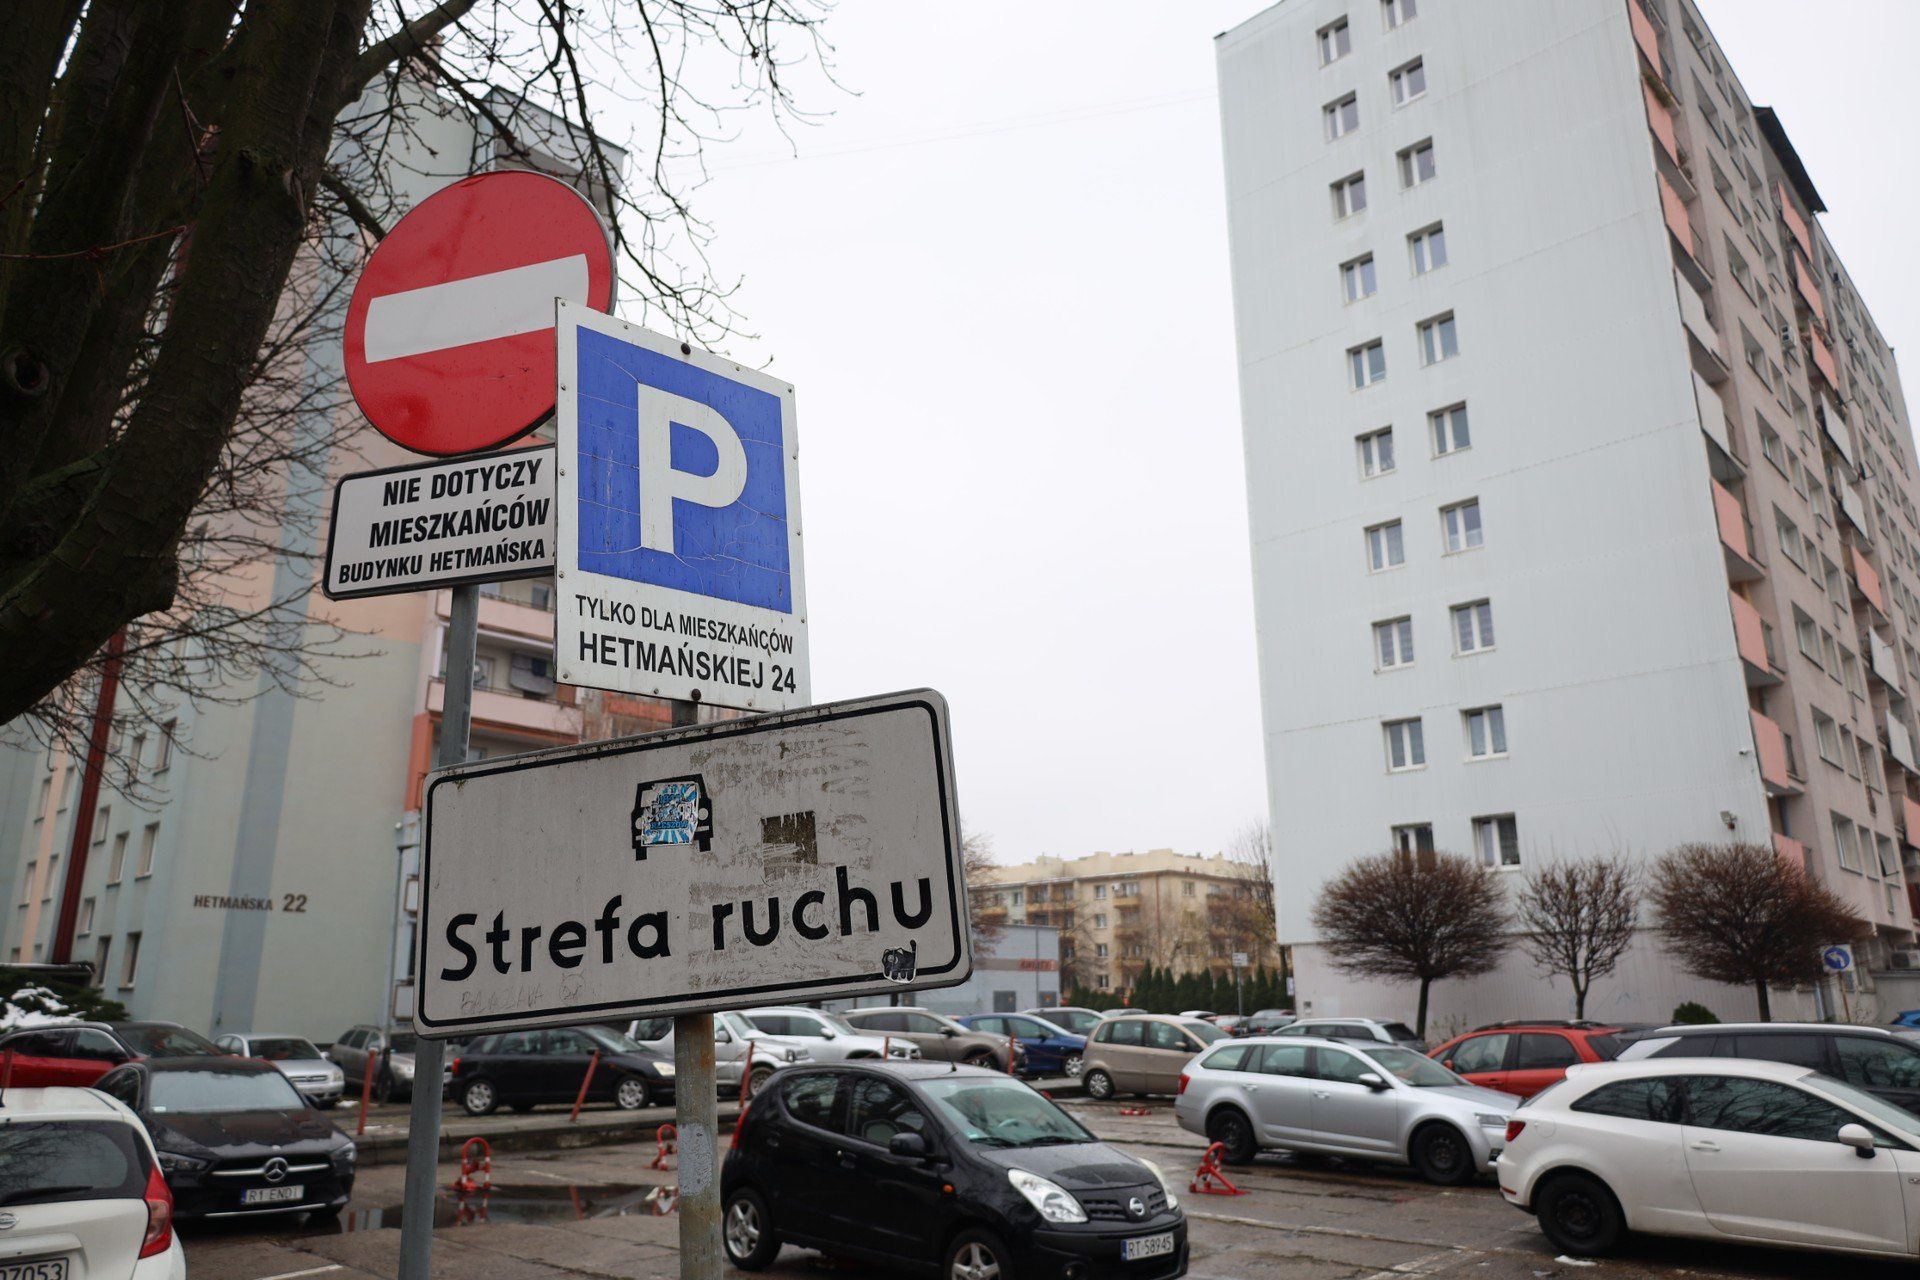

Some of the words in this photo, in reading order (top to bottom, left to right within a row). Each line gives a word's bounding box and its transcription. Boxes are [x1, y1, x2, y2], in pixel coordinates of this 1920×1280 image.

[383, 477, 421, 507] NIE
[430, 458, 543, 500] DOTYCZY
[638, 382, 748, 554] P
[368, 494, 551, 548] MIESZKAŃCÓW
[338, 554, 423, 584] BUDYNKU
[429, 537, 545, 572] HETMAŃSKA
[575, 594, 636, 626] TYLKO
[641, 606, 675, 633] DLA
[679, 614, 793, 654] MIESZKAŃCÓW
[579, 630, 764, 689] HETMAŃSKIEJ
[771, 664, 797, 694] 24
[193, 894, 273, 911] HETMAŃSKA
[283, 893, 308, 913] 22
[440, 894, 671, 982] Strefa
[712, 865, 933, 950] ruchu
[1128, 1240, 1142, 1258] RT
